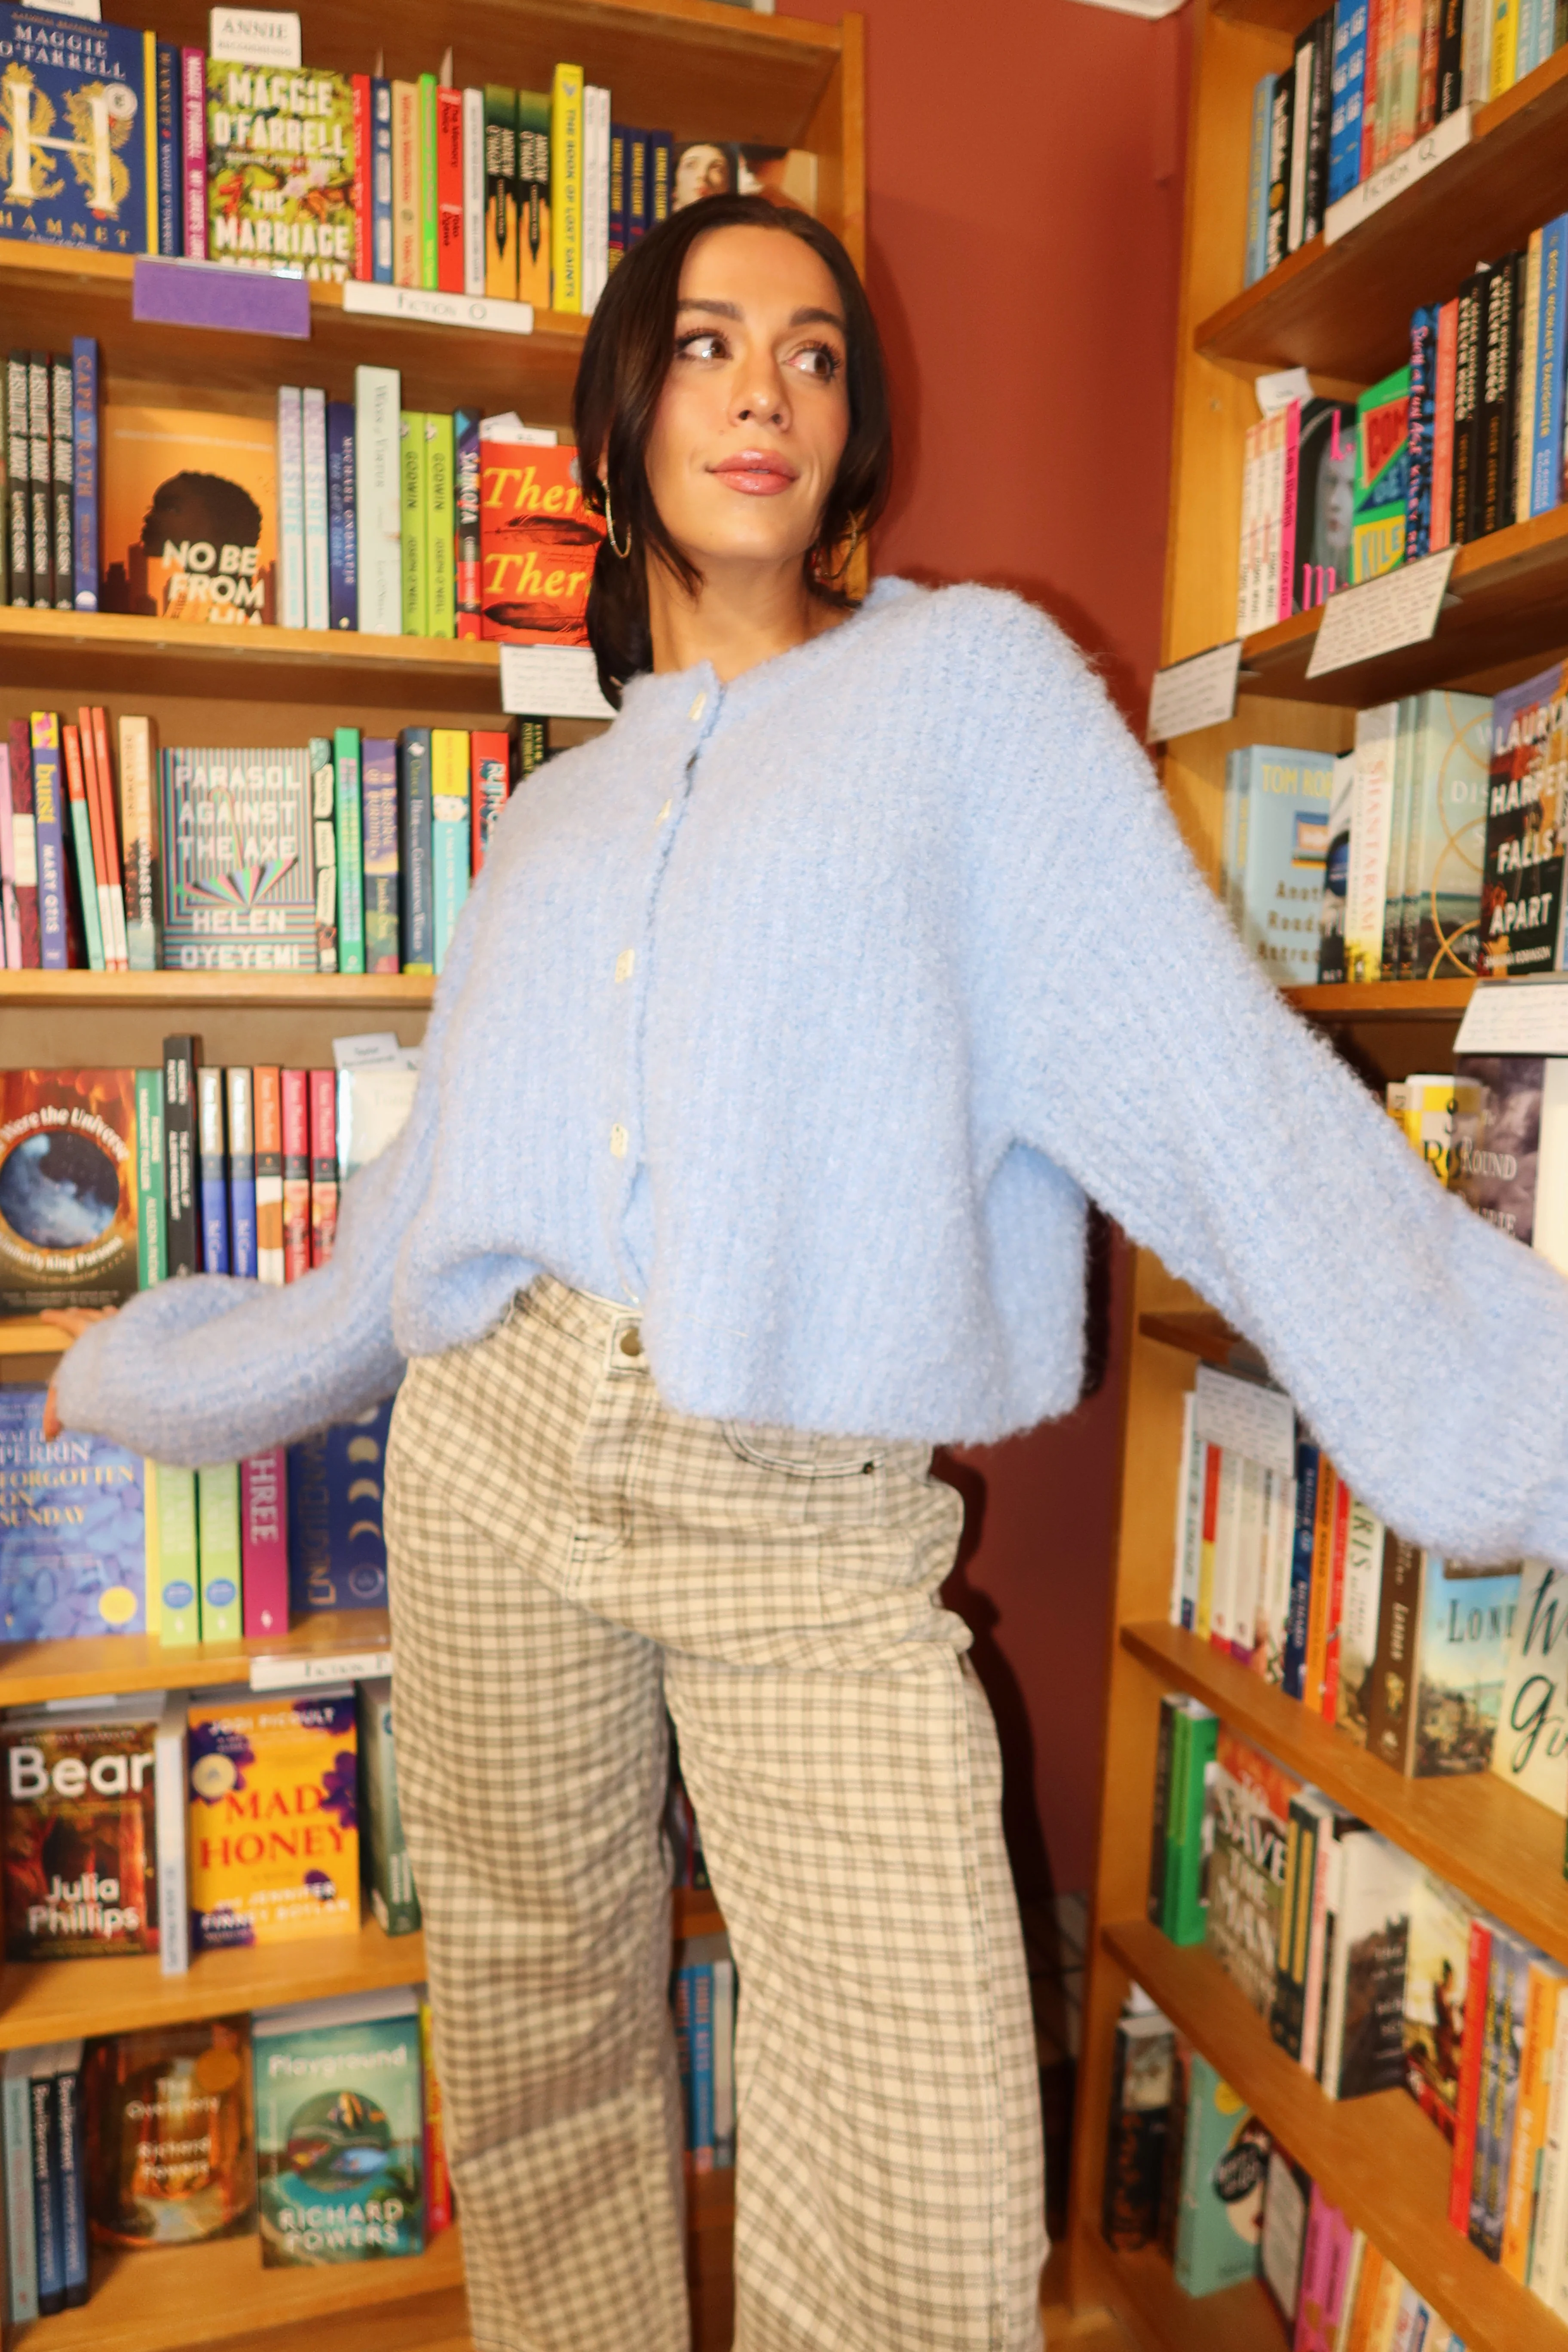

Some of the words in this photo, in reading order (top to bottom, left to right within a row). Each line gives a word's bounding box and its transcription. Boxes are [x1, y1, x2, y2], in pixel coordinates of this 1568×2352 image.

[14, 24, 107, 59] MAGGIE
[222, 18, 288, 39] ANNIE
[0, 41, 126, 80] O'FARRELL
[228, 72, 333, 116] MAGGIE
[215, 112, 349, 156] O'FARRELL
[565, 110, 576, 135] THE
[565, 140, 575, 179] BOOK
[1419, 138, 1436, 161] Q
[565, 185, 575, 202] OF
[0, 210, 130, 247] HAMNET
[215, 215, 350, 258] MARRIAGE
[565, 208, 575, 241] LOST
[564, 247, 575, 297] SAINTS
[469, 303, 486, 319] O
[76, 355, 92, 411] CAPE
[77, 418, 92, 497] WRATH
[406, 452, 417, 509] GODWIN
[432, 453, 444, 511] GODWIN
[482, 466, 597, 514] Ther
[162, 539, 216, 572] NO
[219, 544, 261, 576] BE
[1361, 524, 1402, 580] KILE
[168, 572, 264, 609] FROM
[484, 552, 591, 598] Ther
[34, 763, 56, 824] burst
[175, 766, 300, 790] PARASOL
[487, 762, 507, 808] RUTH
[1262, 765, 1297, 794] TOM
[1302, 769, 1334, 799] ROB
[179, 800, 297, 824] AGAINST
[43, 844, 57, 890] MARY
[178, 836, 233, 859] THE
[244, 836, 296, 859] AXE
[1497, 828, 1555, 875] FALLS
[45, 894, 59, 934] OTIS
[193, 910, 286, 934] HELEN
[1488, 892, 1553, 937] APART
[181, 945, 300, 969] OYEYEMI
[40, 1106, 69, 1125] the
[70, 1107, 130, 1162] Universe
[0, 1441, 91, 1466] PERRIN
[1351, 1514, 1373, 1570] RIS
[9, 1746, 154, 1801] Bear
[225, 1783, 325, 1824] MAD
[200, 1825, 343, 1869] HONEY
[45, 1871, 120, 1905] Julia
[27, 1902, 140, 1939] Phillips
[269, 2043, 407, 2079] Playground
[278, 2198, 404, 2230] RICHARD
[285, 2223, 398, 2255] POWERS
